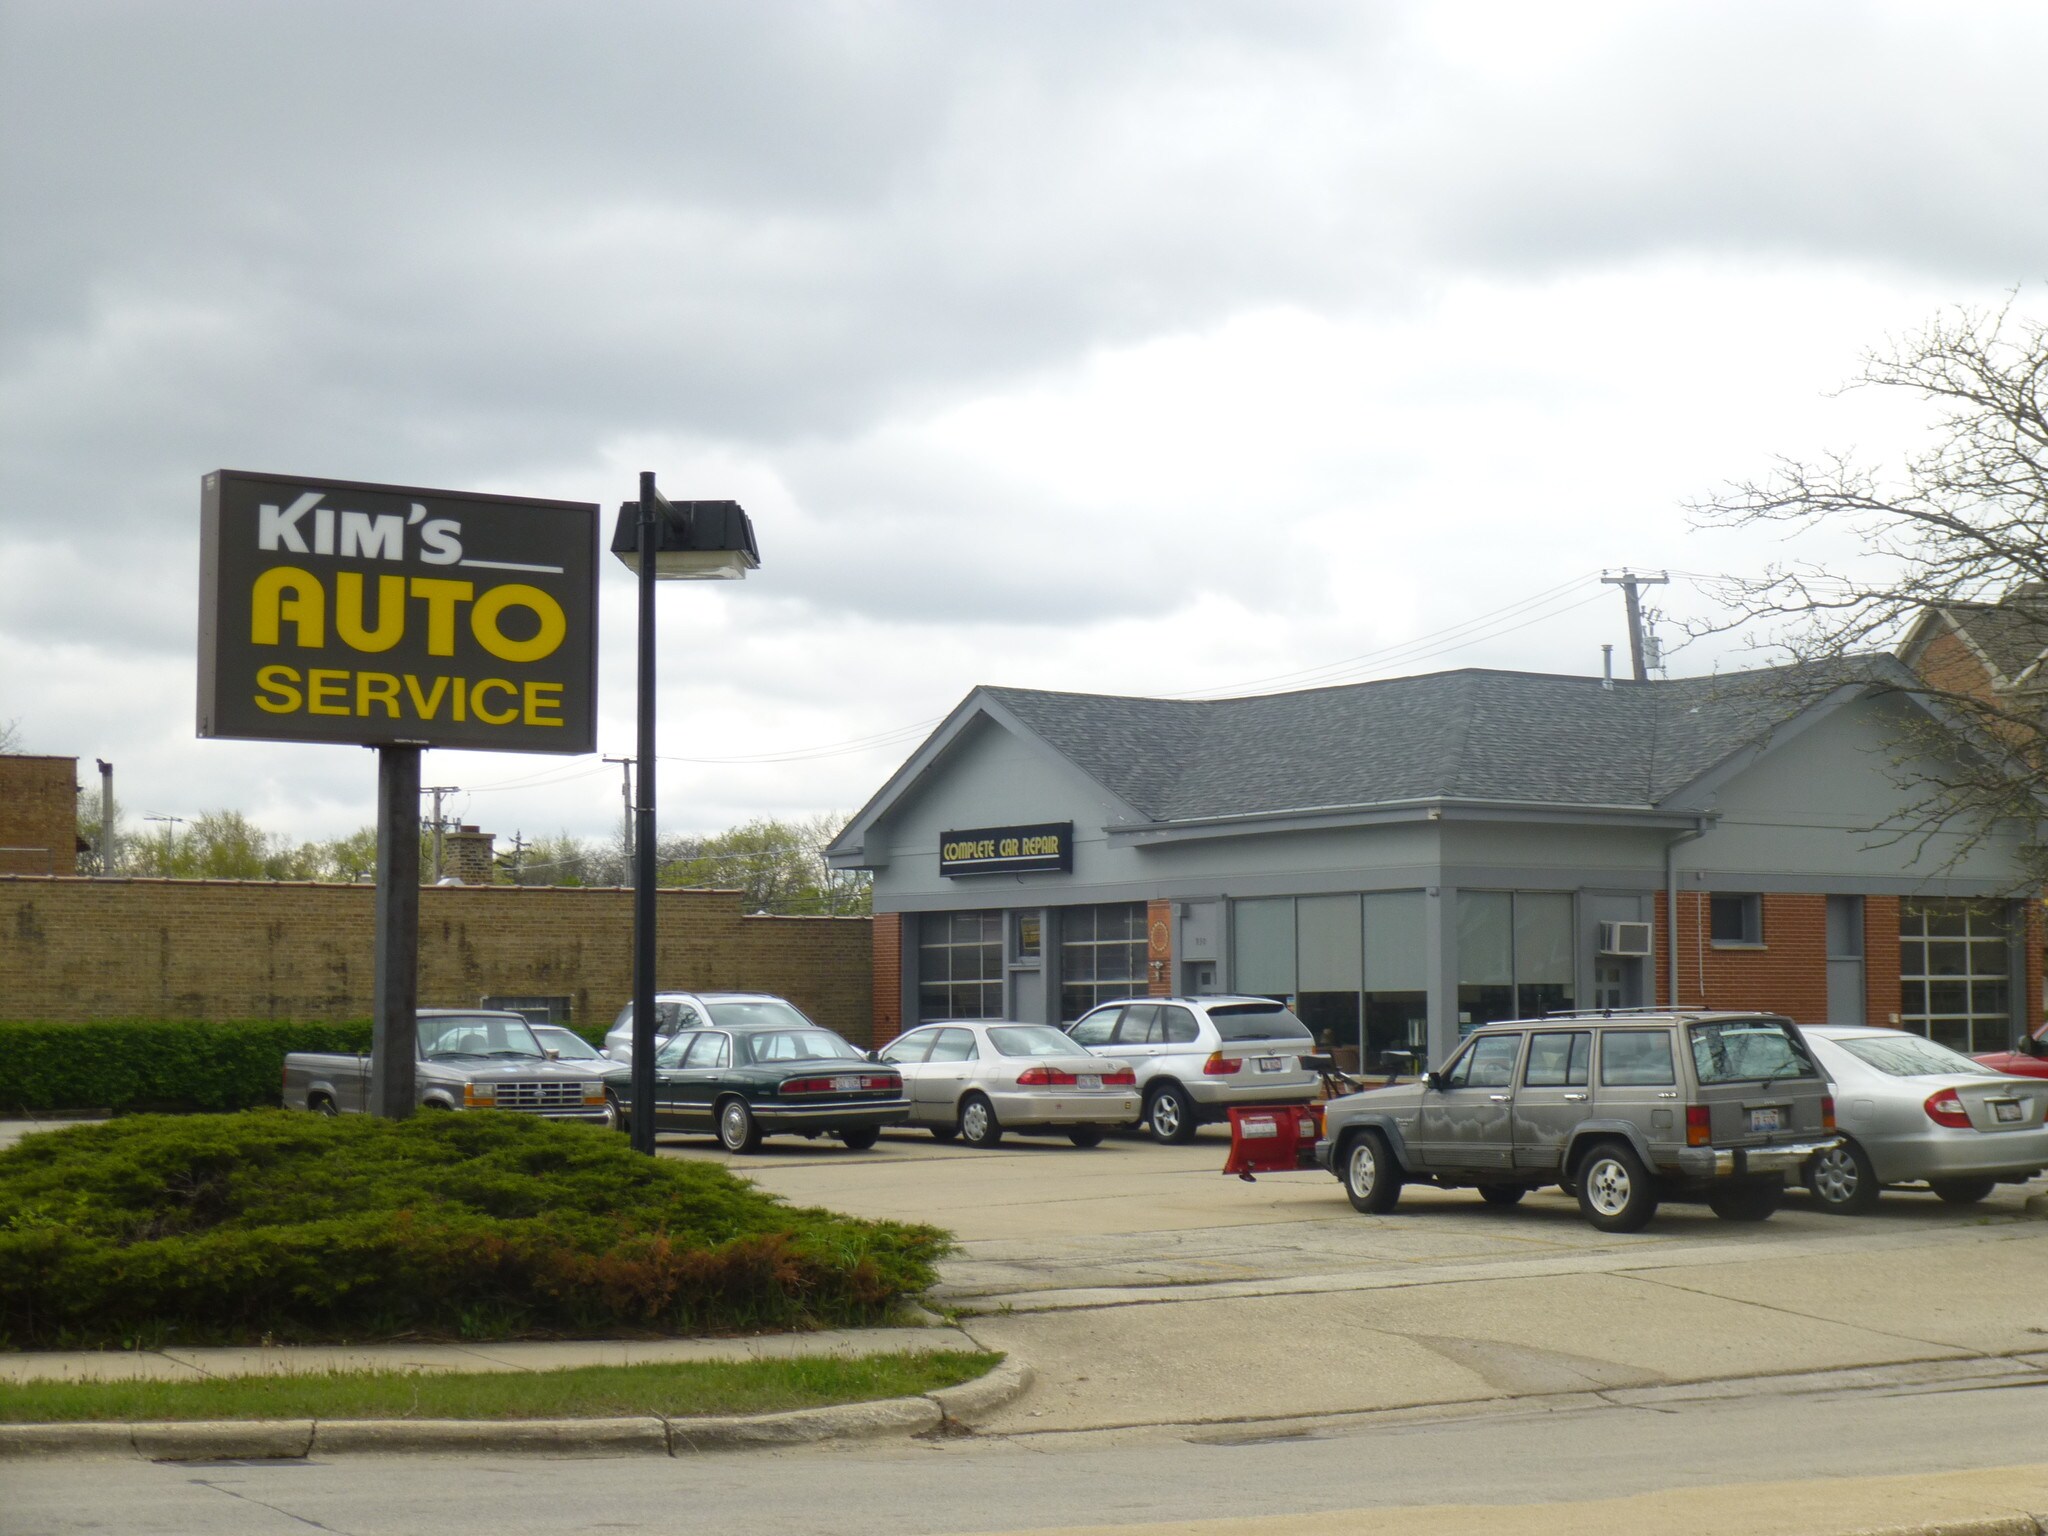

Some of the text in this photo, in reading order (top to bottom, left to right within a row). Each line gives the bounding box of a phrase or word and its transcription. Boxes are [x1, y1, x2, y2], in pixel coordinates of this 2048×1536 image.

[258, 491, 463, 566] KIM'S
[251, 565, 567, 663] AUTO
[253, 664, 565, 727] SERVICE
[943, 835, 1060, 861] COMPLETE CAR REPAIR
